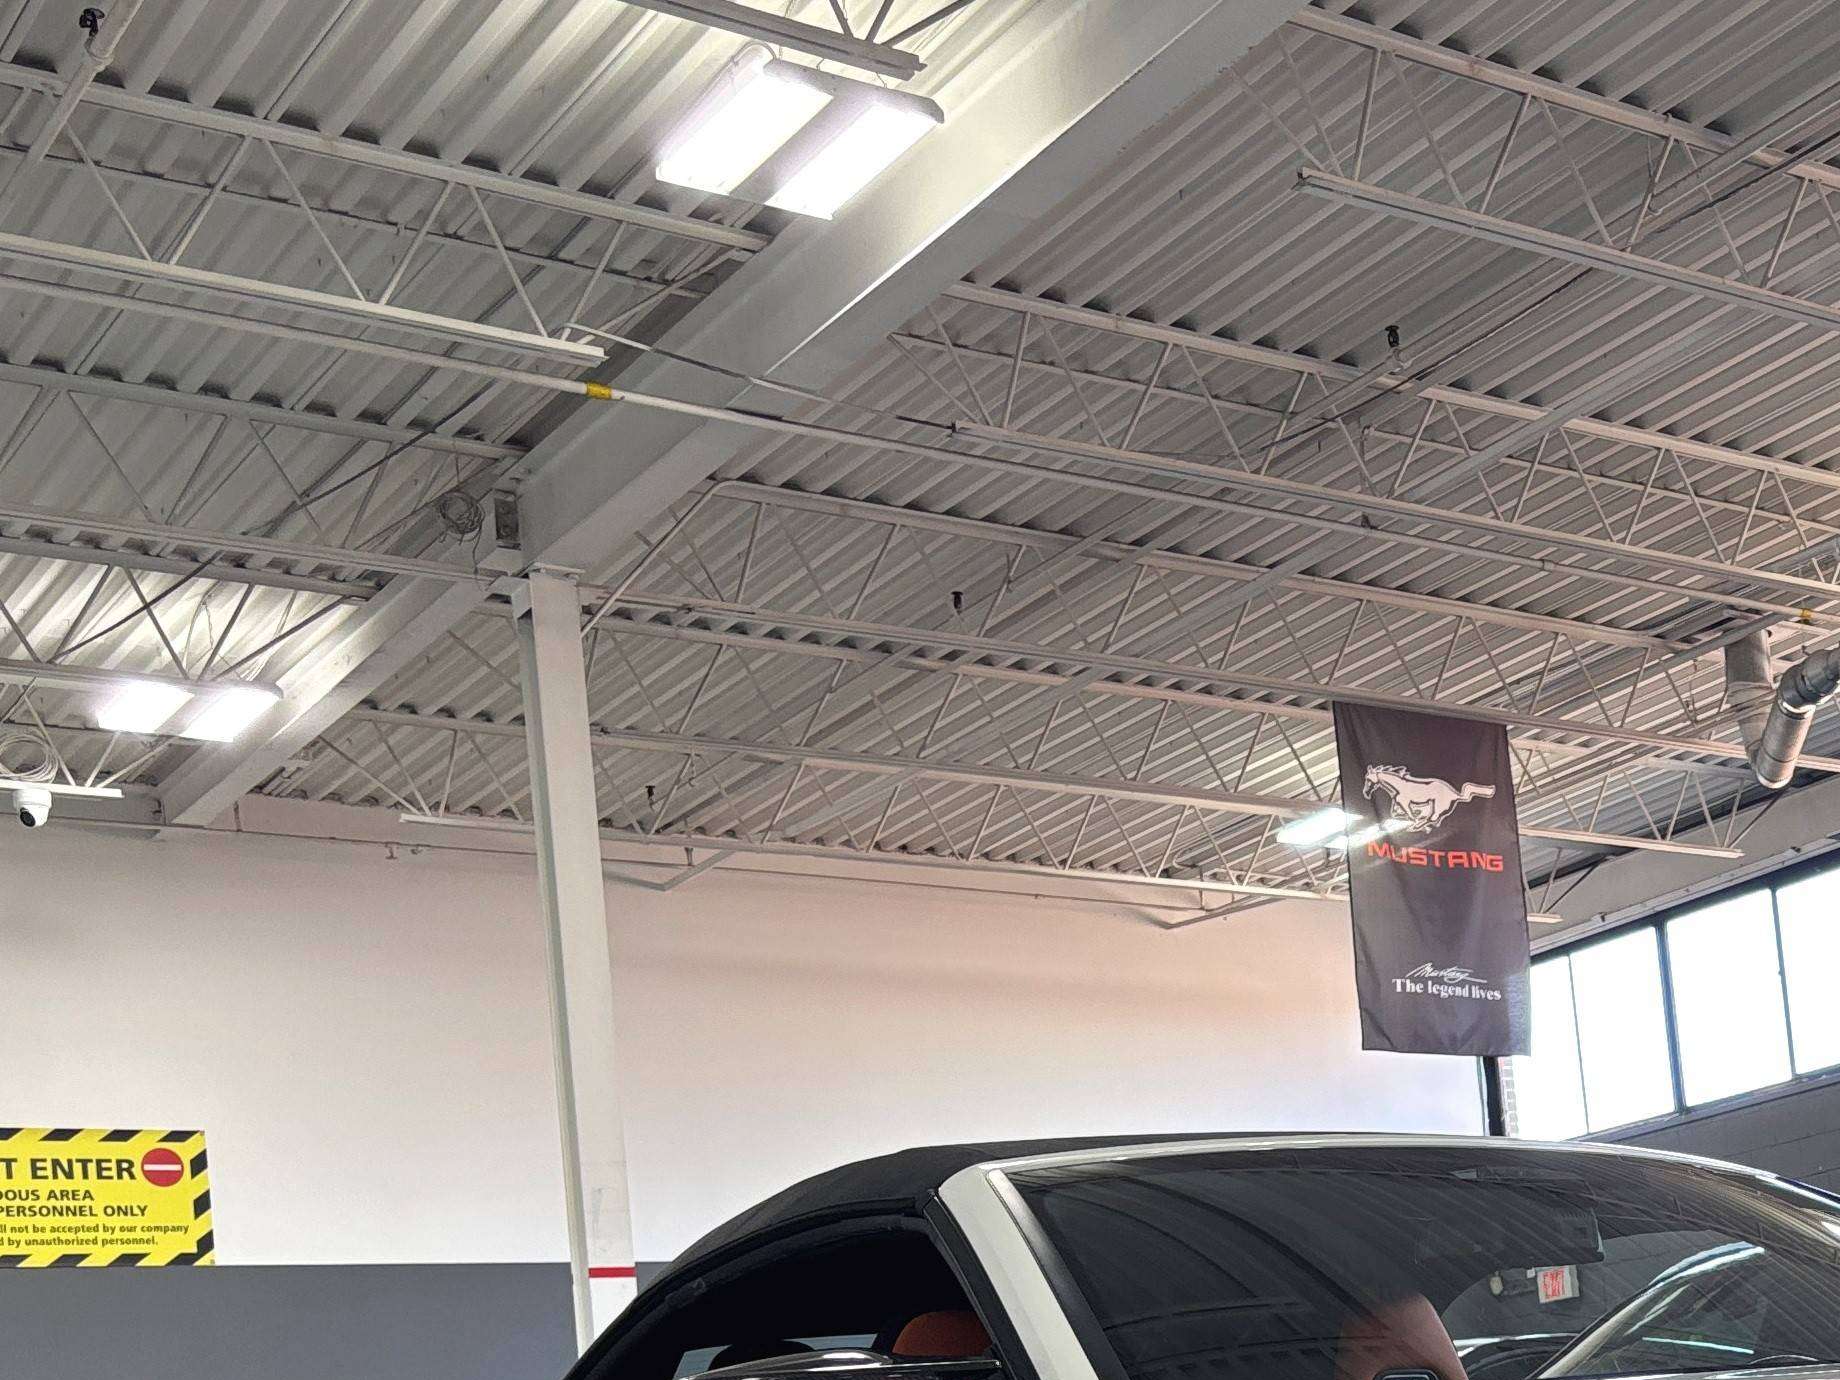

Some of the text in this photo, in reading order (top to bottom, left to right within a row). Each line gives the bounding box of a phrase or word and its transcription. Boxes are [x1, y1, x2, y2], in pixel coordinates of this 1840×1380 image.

[1367, 841, 1504, 873] MUSTANG
[1391, 978, 1502, 1001] The legend lives
[29, 1158, 137, 1180] ENTER
[0, 1189, 95, 1202] OUS AREA
[103, 1204, 148, 1217] ONLY
[10, 1224, 29, 1234] not
[32, 1223, 47, 1234] be
[49, 1223, 100, 1235] accepted
[103, 1223, 117, 1235] by
[119, 1224, 138, 1233] our
[140, 1224, 190, 1235] company
[7, 1236, 22, 1249] by
[24, 1236, 99, 1247] unauthorized
[101, 1235, 159, 1248] personnel.
